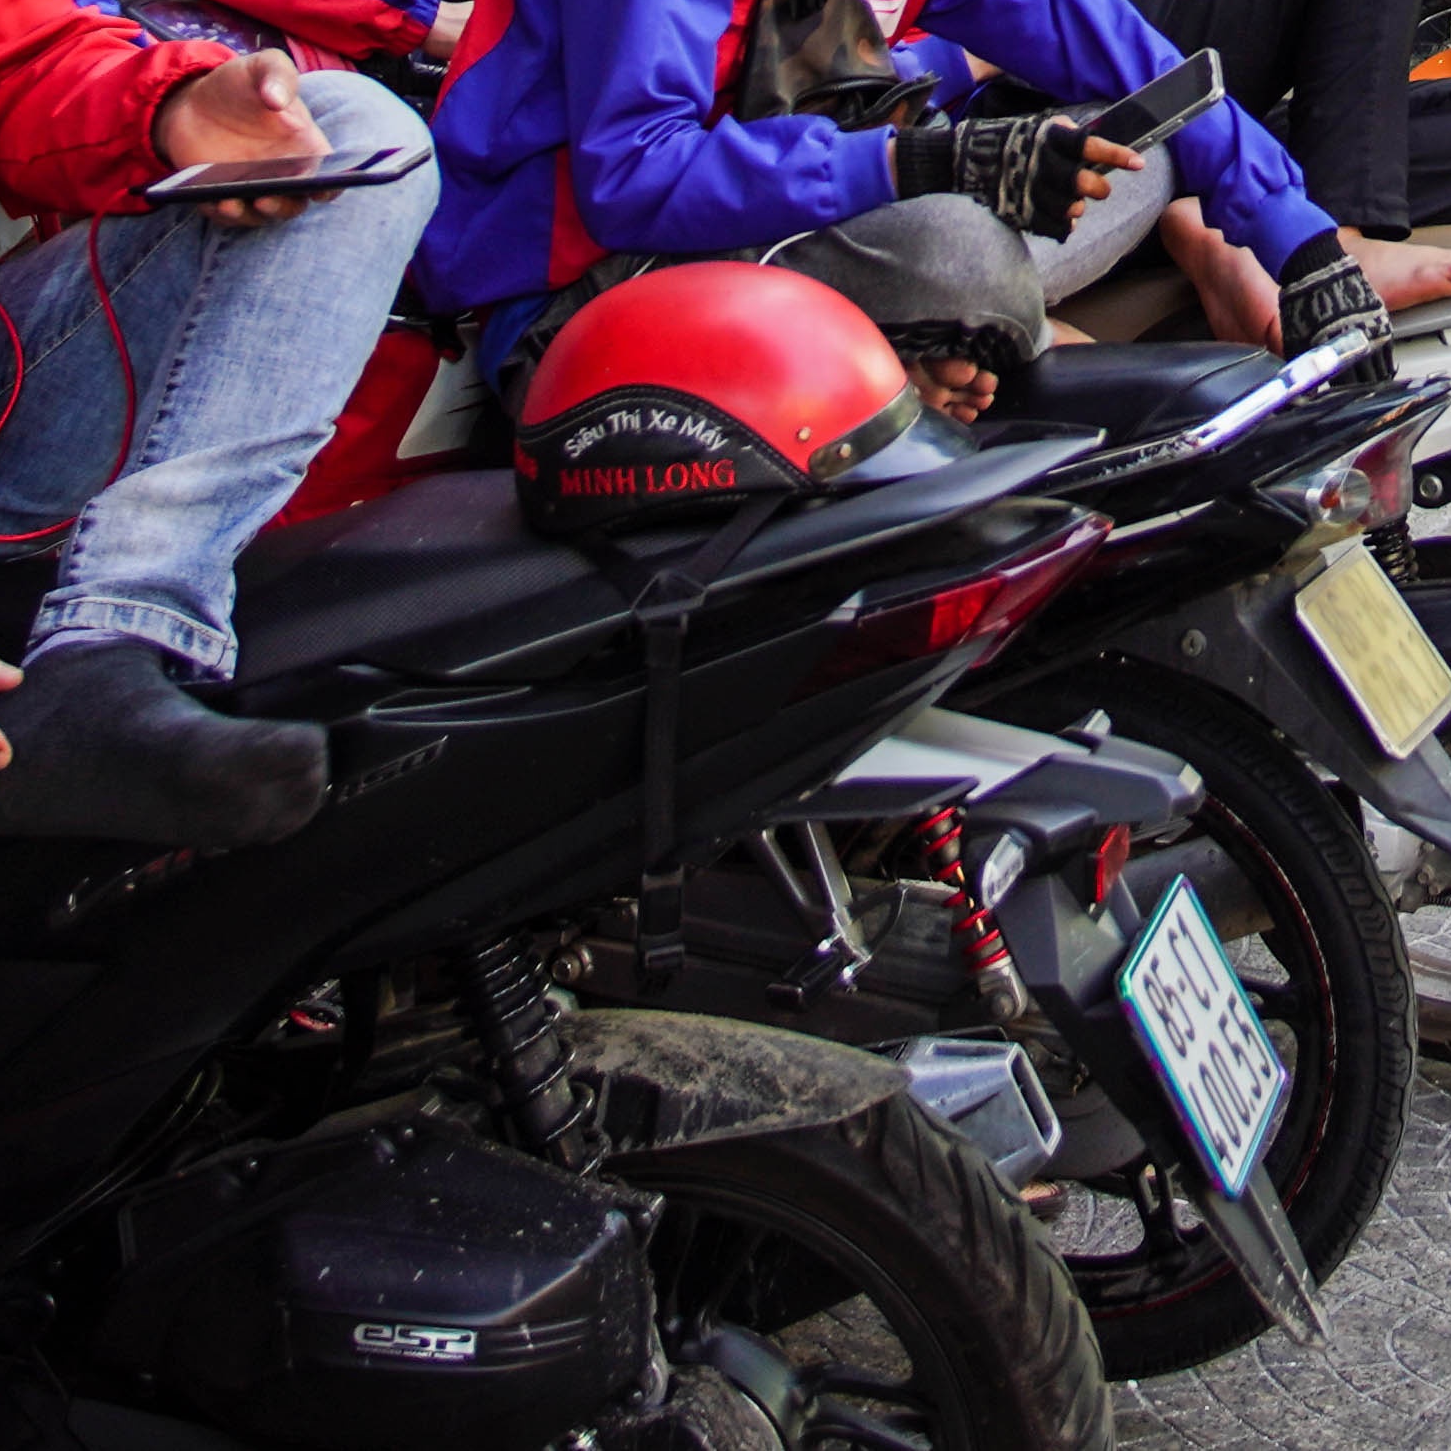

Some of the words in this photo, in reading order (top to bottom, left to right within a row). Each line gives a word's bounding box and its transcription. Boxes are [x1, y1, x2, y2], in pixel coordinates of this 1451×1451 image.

[564, 424, 606, 458] Siêu
[607, 408, 641, 434] Thị
[647, 408, 677, 430] Xe
[679, 415, 729, 451] Máy
[559, 465, 637, 496] MINH
[646, 458, 736, 493] LONG
